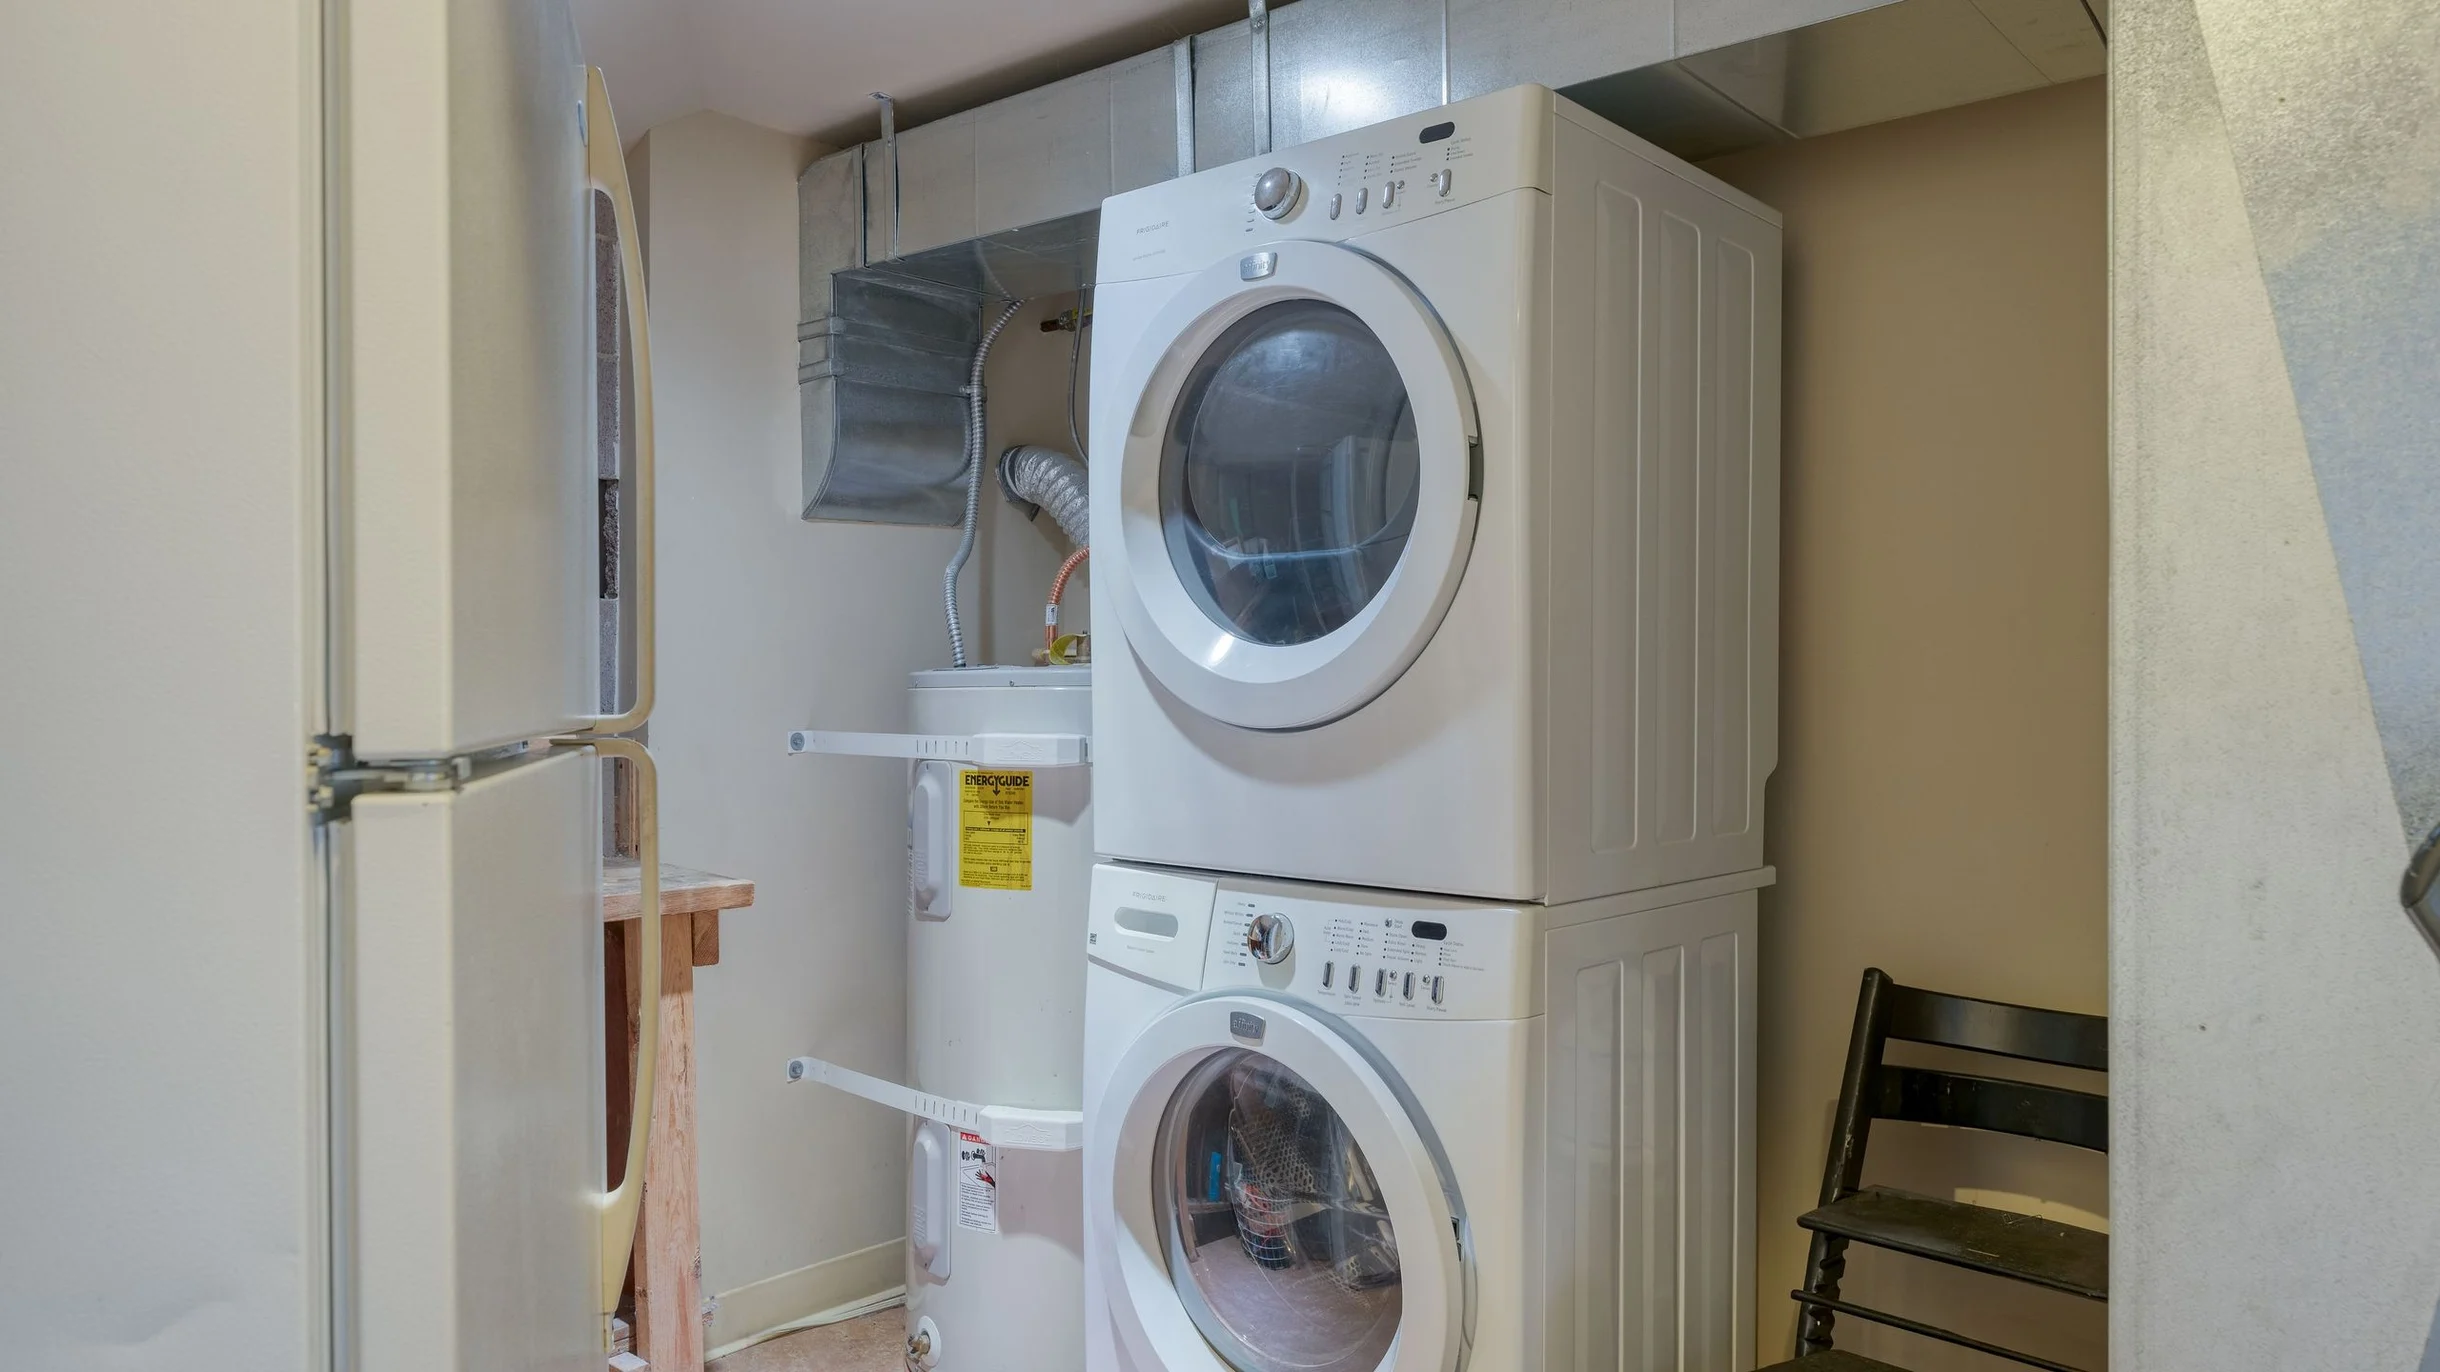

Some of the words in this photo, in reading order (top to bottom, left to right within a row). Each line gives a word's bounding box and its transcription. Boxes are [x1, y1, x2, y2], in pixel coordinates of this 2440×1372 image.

[1136, 220, 1169, 235] FRIGIDAIRE
[965, 774, 1030, 787] ENERGYGUIDE
[1132, 891, 1168, 903] FRIGIDAIRE
